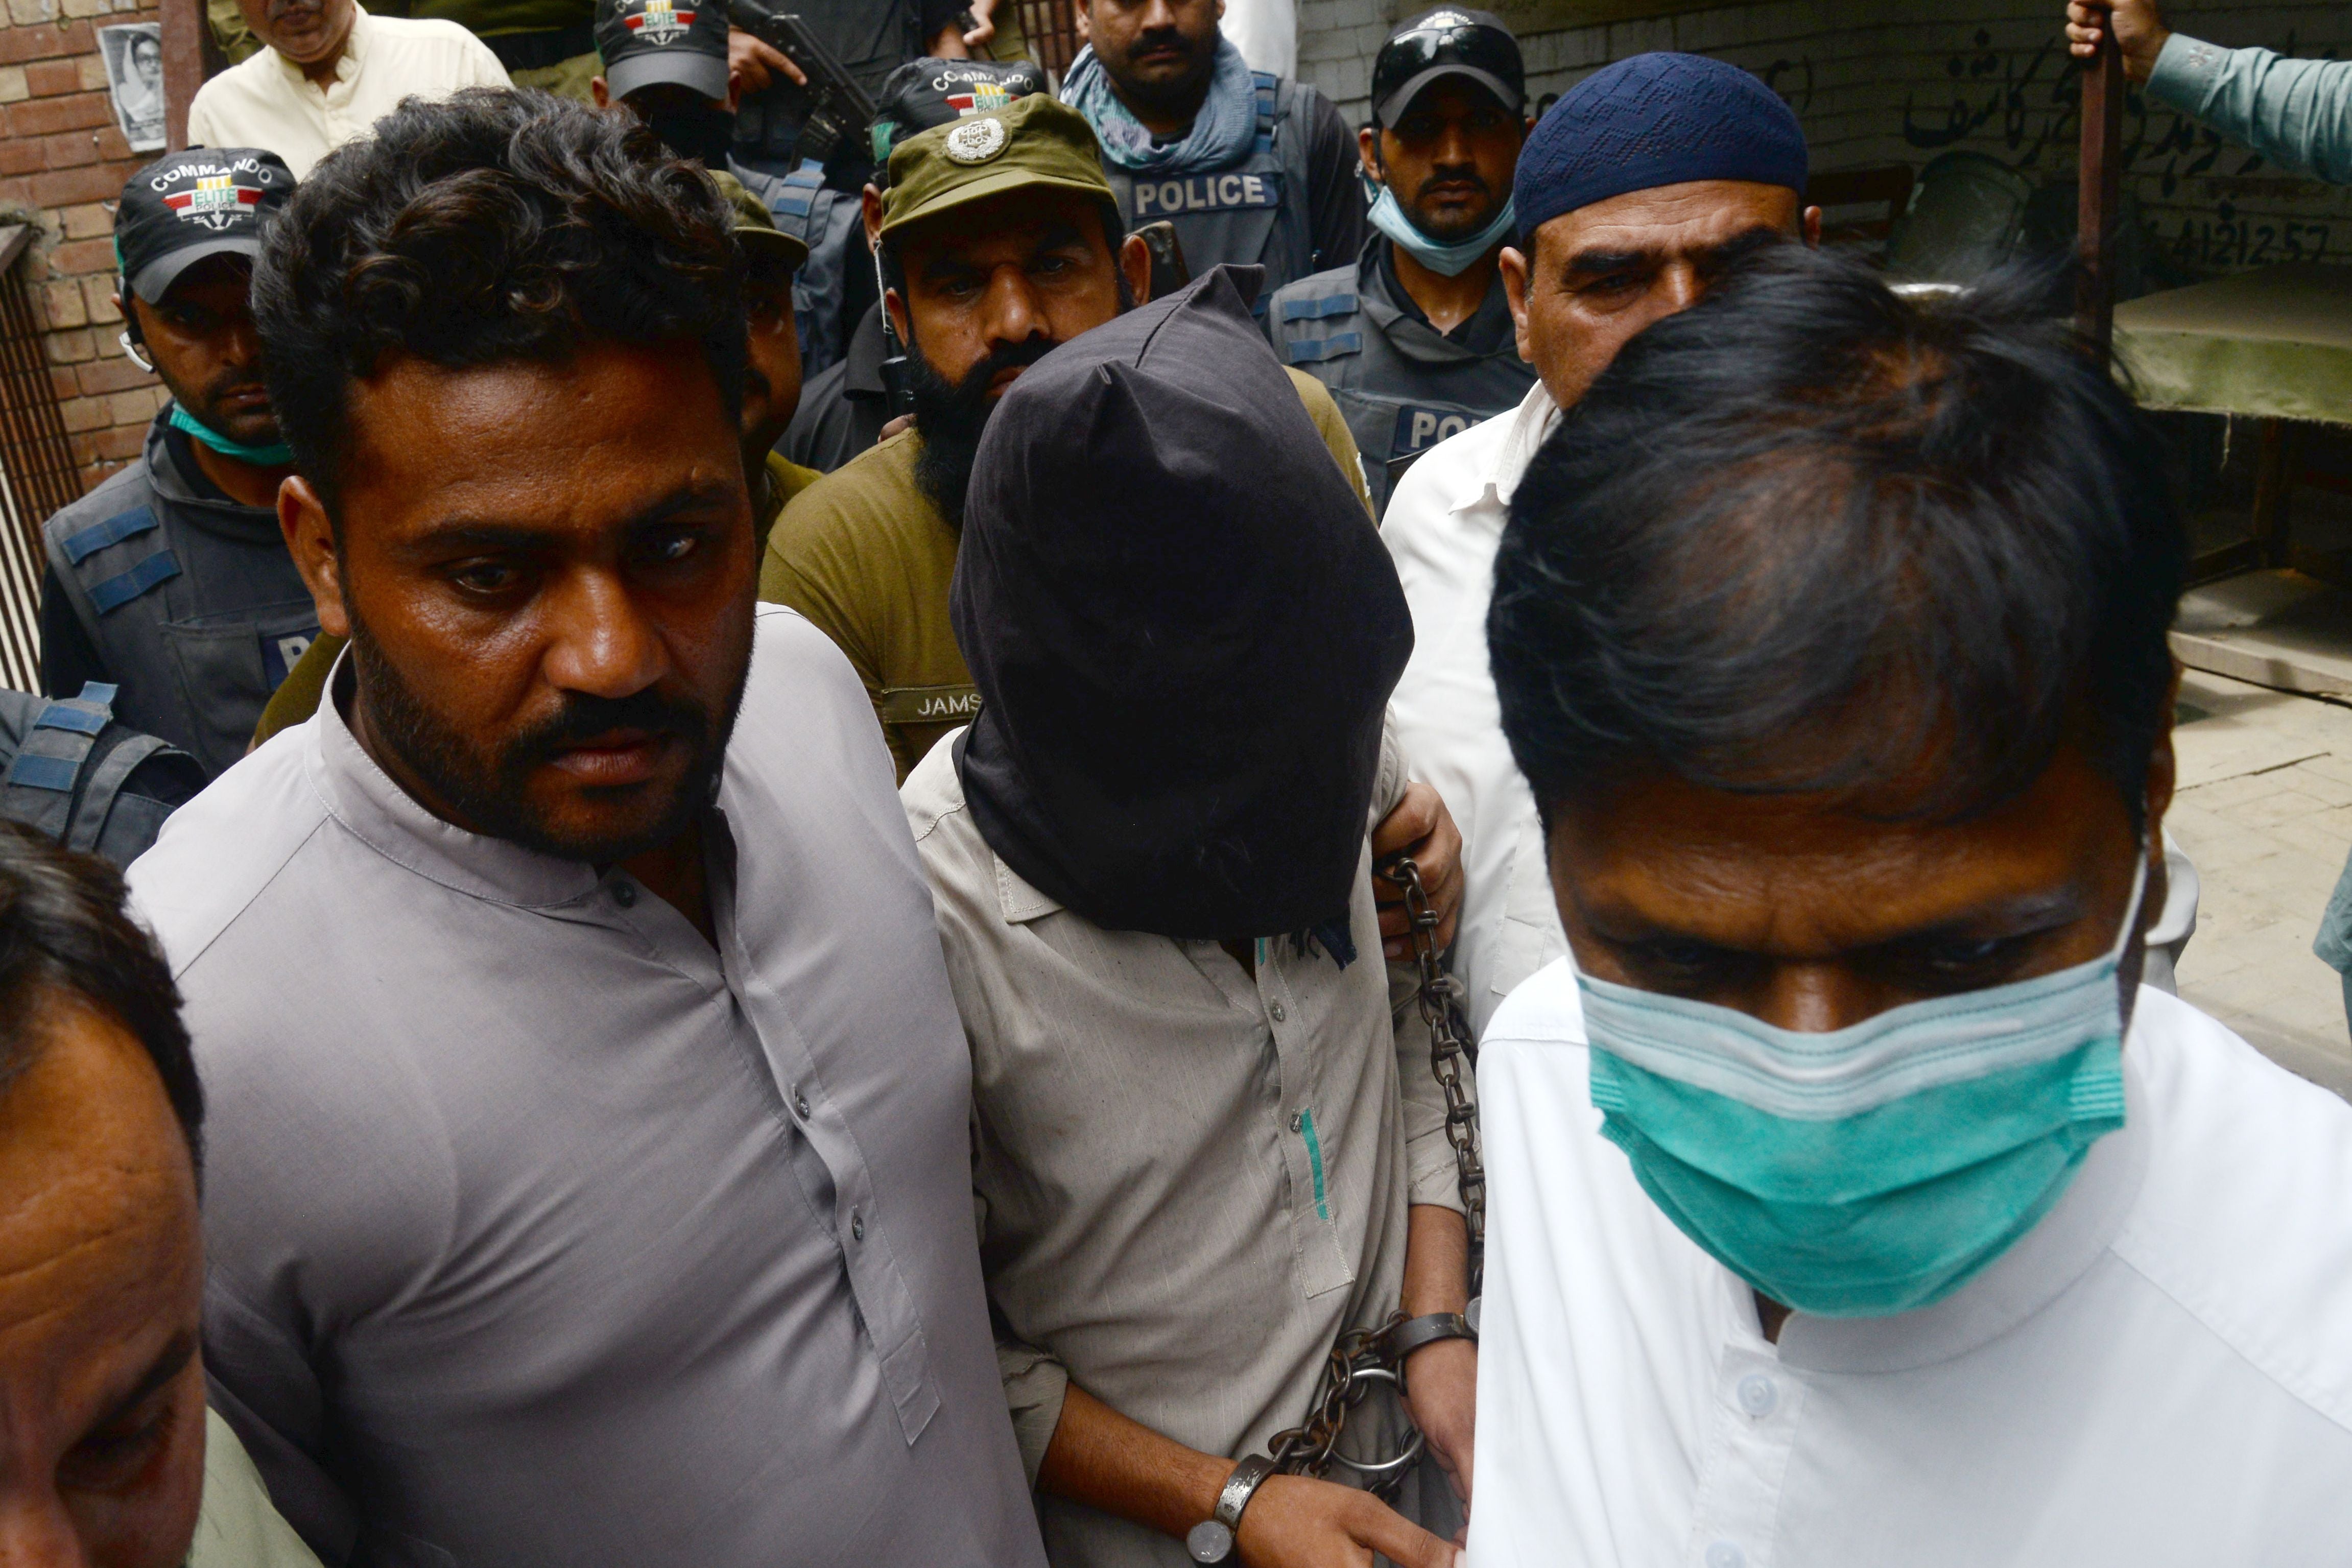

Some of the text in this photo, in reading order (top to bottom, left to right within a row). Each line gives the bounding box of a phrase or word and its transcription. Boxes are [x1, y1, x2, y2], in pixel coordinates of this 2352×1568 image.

[151, 158, 272, 192] COMMANDO
[194, 188, 236, 205] ELITE
[196, 202, 235, 211] POLICE
[1135, 175, 1266, 215] POLICE
